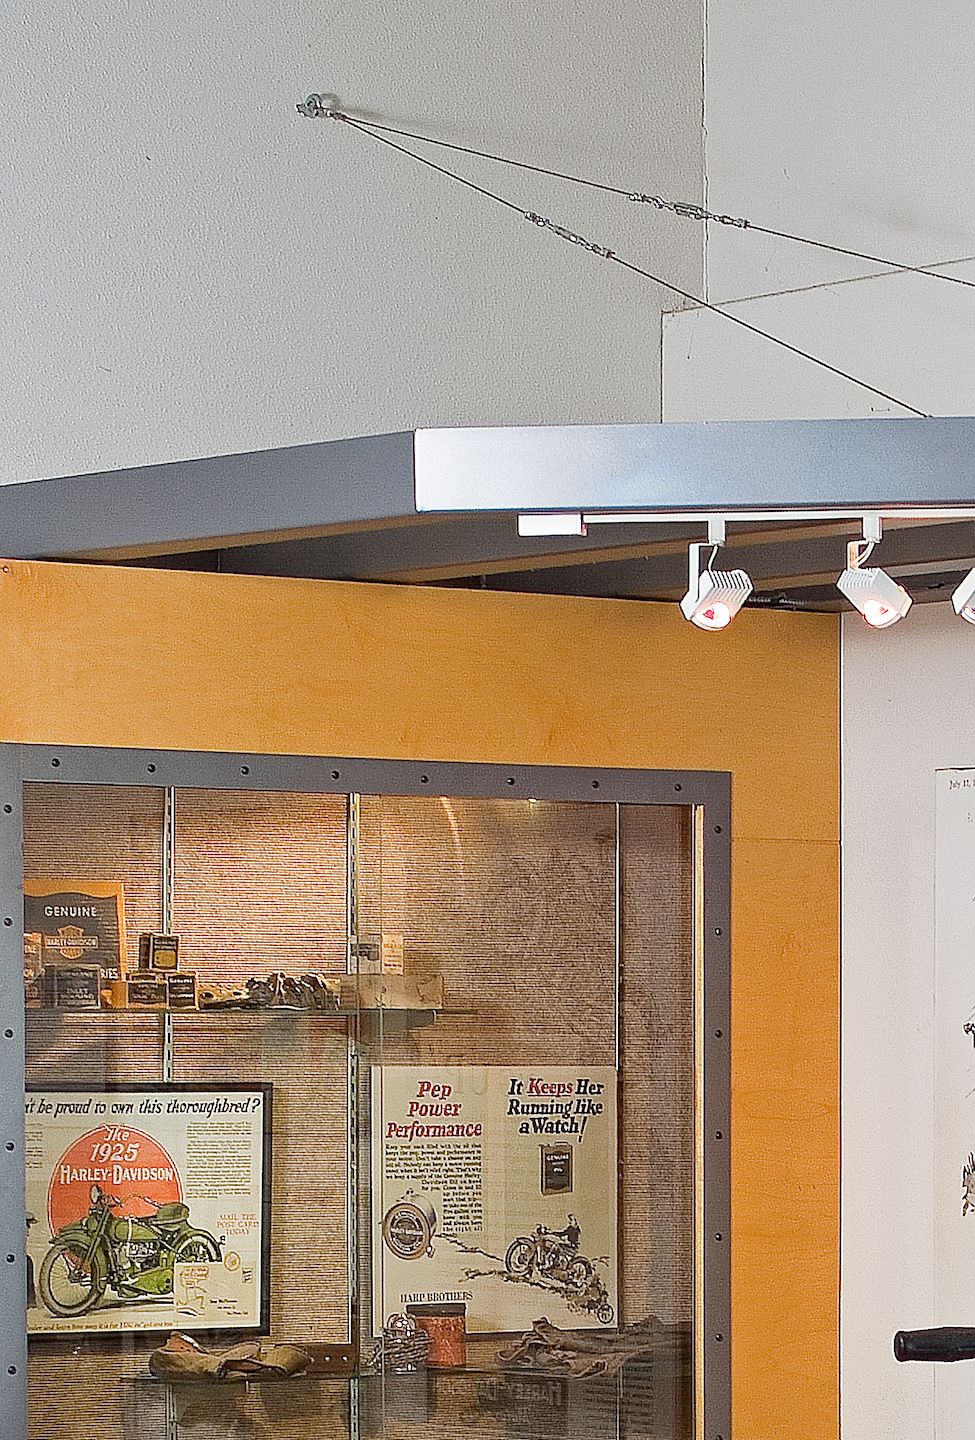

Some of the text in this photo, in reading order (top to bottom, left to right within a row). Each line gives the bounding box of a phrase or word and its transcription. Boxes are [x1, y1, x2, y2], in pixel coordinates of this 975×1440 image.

[44, 906, 97, 917] GENUINE
[416, 1081, 452, 1100] Pep
[508, 1078, 604, 1097] It Keeps Her
[37, 1100, 52, 1113] be
[54, 1099, 90, 1118] proud
[95, 1100, 106, 1114] to
[111, 1103, 134, 1113] own
[139, 1099, 161, 1114] this
[166, 1098, 260, 1118] thoroughbred?
[407, 1101, 462, 1117] Power
[507, 1099, 603, 1119] Running like
[103, 1125, 129, 1142] The
[386, 1122, 482, 1141] Performance
[519, 1117, 587, 1142] a Watch!
[91, 1142, 140, 1163] 1925
[60, 1165, 173, 1185] HARLEY-DAVIDSON
